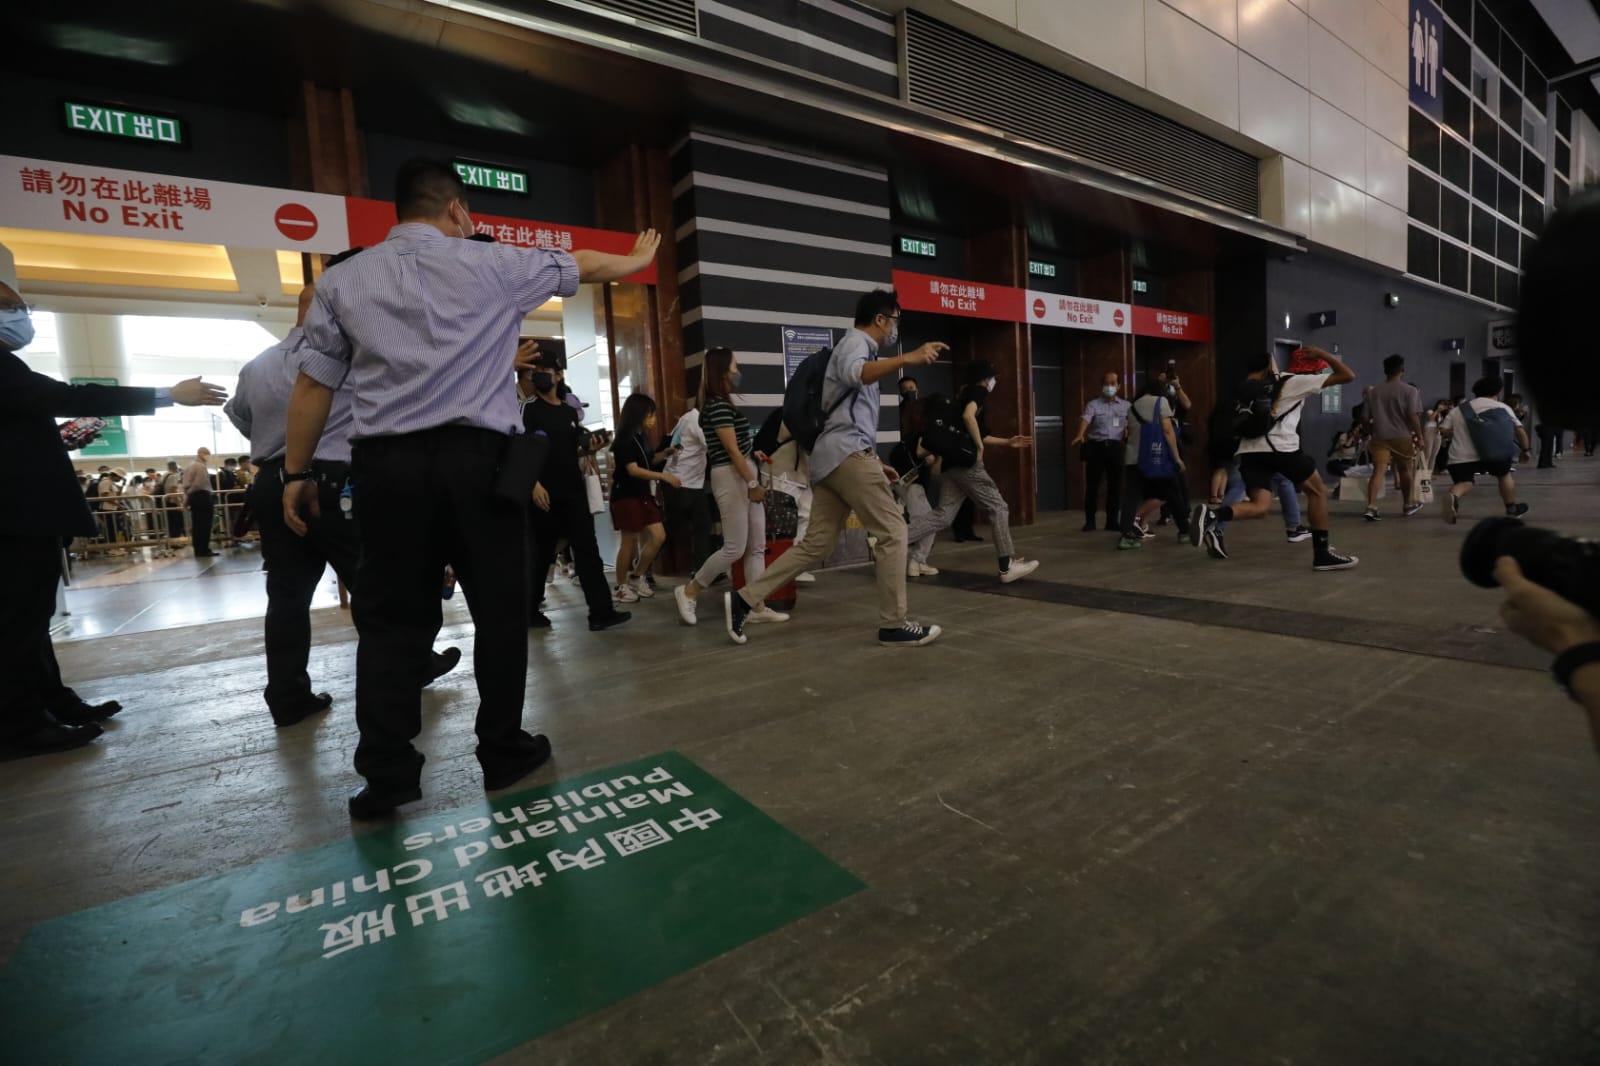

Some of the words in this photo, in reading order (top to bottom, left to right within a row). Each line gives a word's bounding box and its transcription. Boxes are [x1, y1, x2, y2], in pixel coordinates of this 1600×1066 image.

[71, 104, 126, 134] EXIT
[133, 115, 176, 142] 出口
[19, 167, 212, 211] 請勿在此離場
[457, 164, 492, 187] EXIT
[496, 172, 524, 192] 出口
[62, 199, 110, 224] No
[122, 205, 184, 231] Exit
[473, 221, 573, 250] 勿在此離場
[900, 237, 919, 254] EXIT
[921, 242, 936, 257] 出口
[1029, 261, 1043, 275] EXIT
[941, 296, 955, 309] No
[957, 298, 977, 312] Exit
[1067, 311, 1078, 322] No
[1080, 313, 1094, 325] Exit
[402, 766, 677, 852] Publishers
[453, 780, 695, 868] Mainland
[239, 859, 434, 929] China
